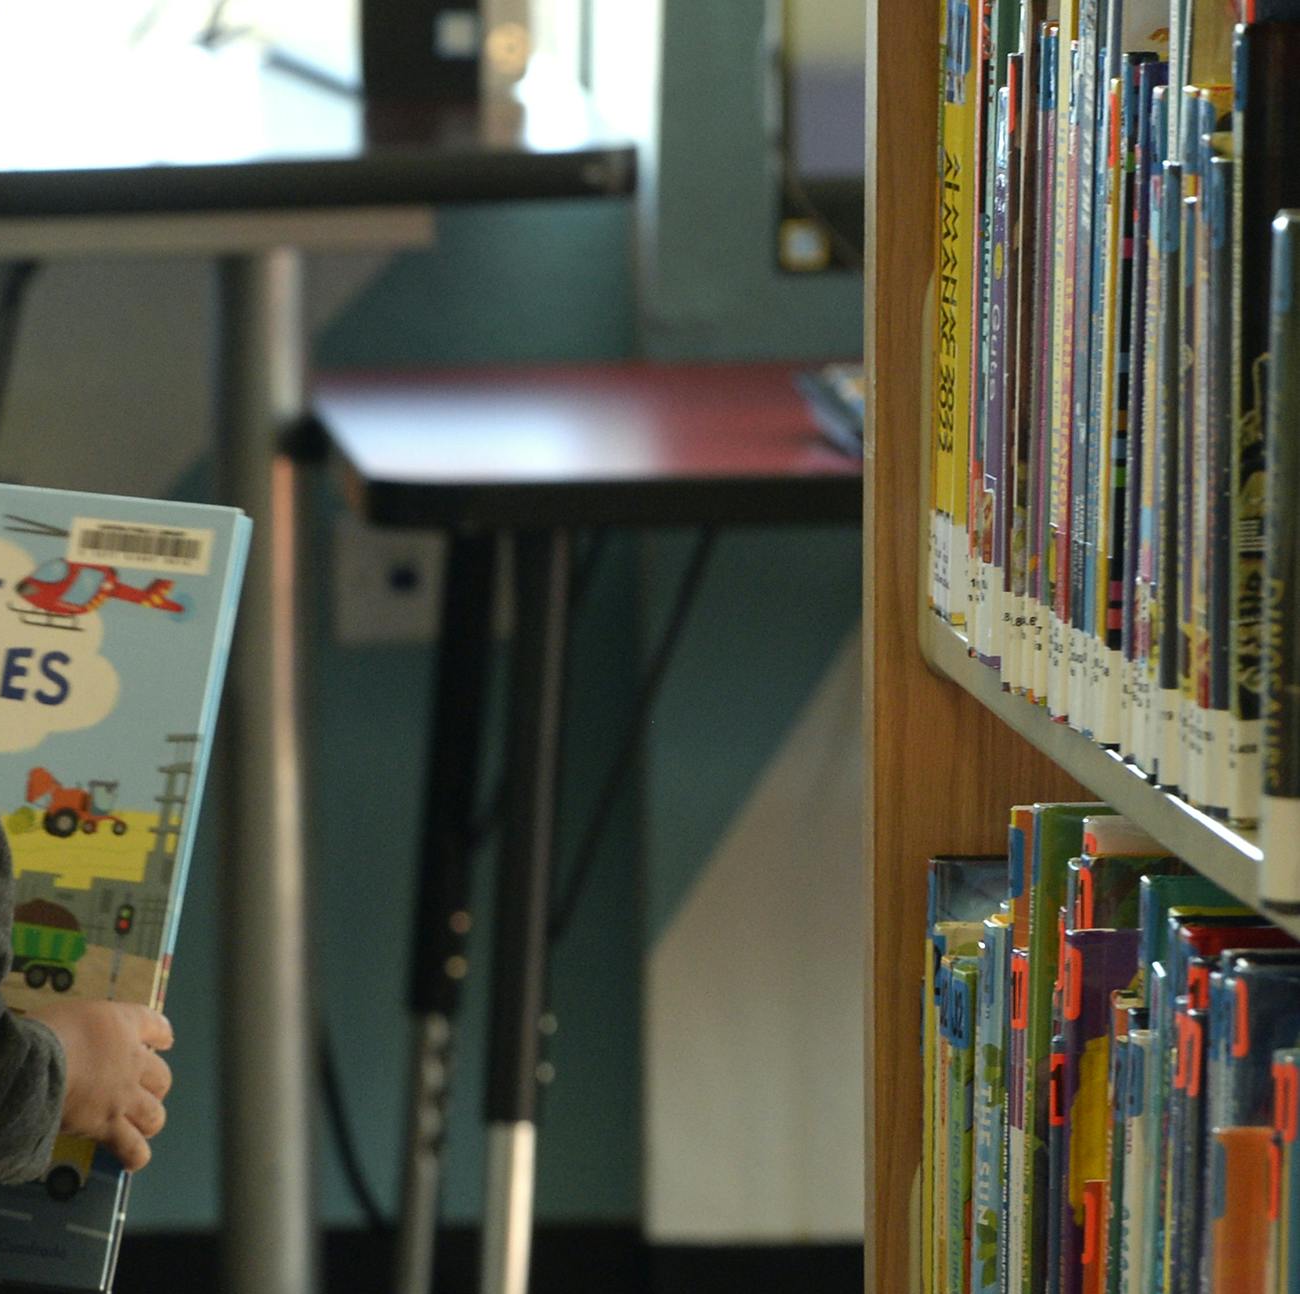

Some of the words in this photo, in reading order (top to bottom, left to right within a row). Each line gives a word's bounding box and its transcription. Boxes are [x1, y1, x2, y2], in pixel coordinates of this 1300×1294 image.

[989, 303, 1002, 401] Guts
[977, 1084, 993, 1147] THE
[976, 1161, 992, 1226] SUN
